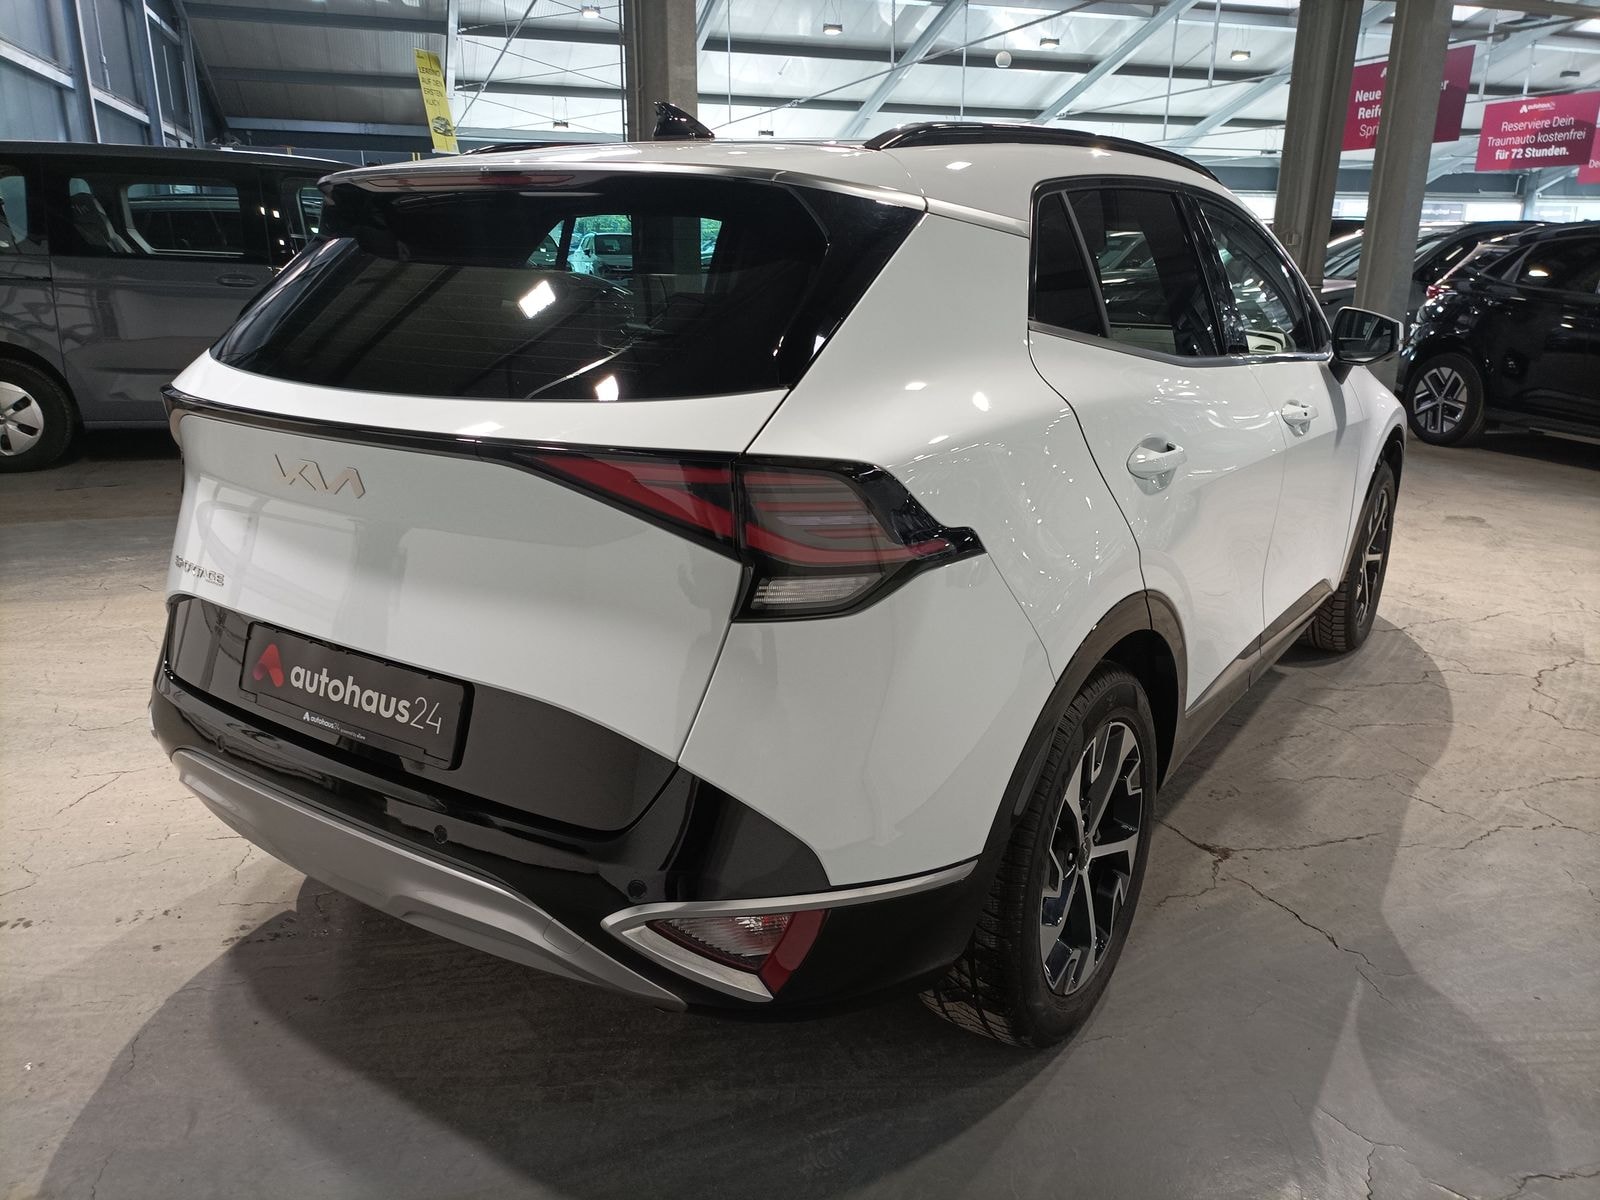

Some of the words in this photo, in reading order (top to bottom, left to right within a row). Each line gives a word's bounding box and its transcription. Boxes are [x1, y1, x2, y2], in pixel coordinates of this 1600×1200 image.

[1355, 90, 1382, 102] Neue
[1501, 118, 1551, 132] Reserviere
[1552, 114, 1575, 127] Dein
[1487, 134, 1536, 147] Traumauto
[1537, 128, 1587, 143] kostenfrei
[1495, 149, 1509, 160] für
[1511, 148, 1523, 159] 72
[1524, 145, 1569, 158] Stunden.
[290, 665, 442, 735] autohaus24
